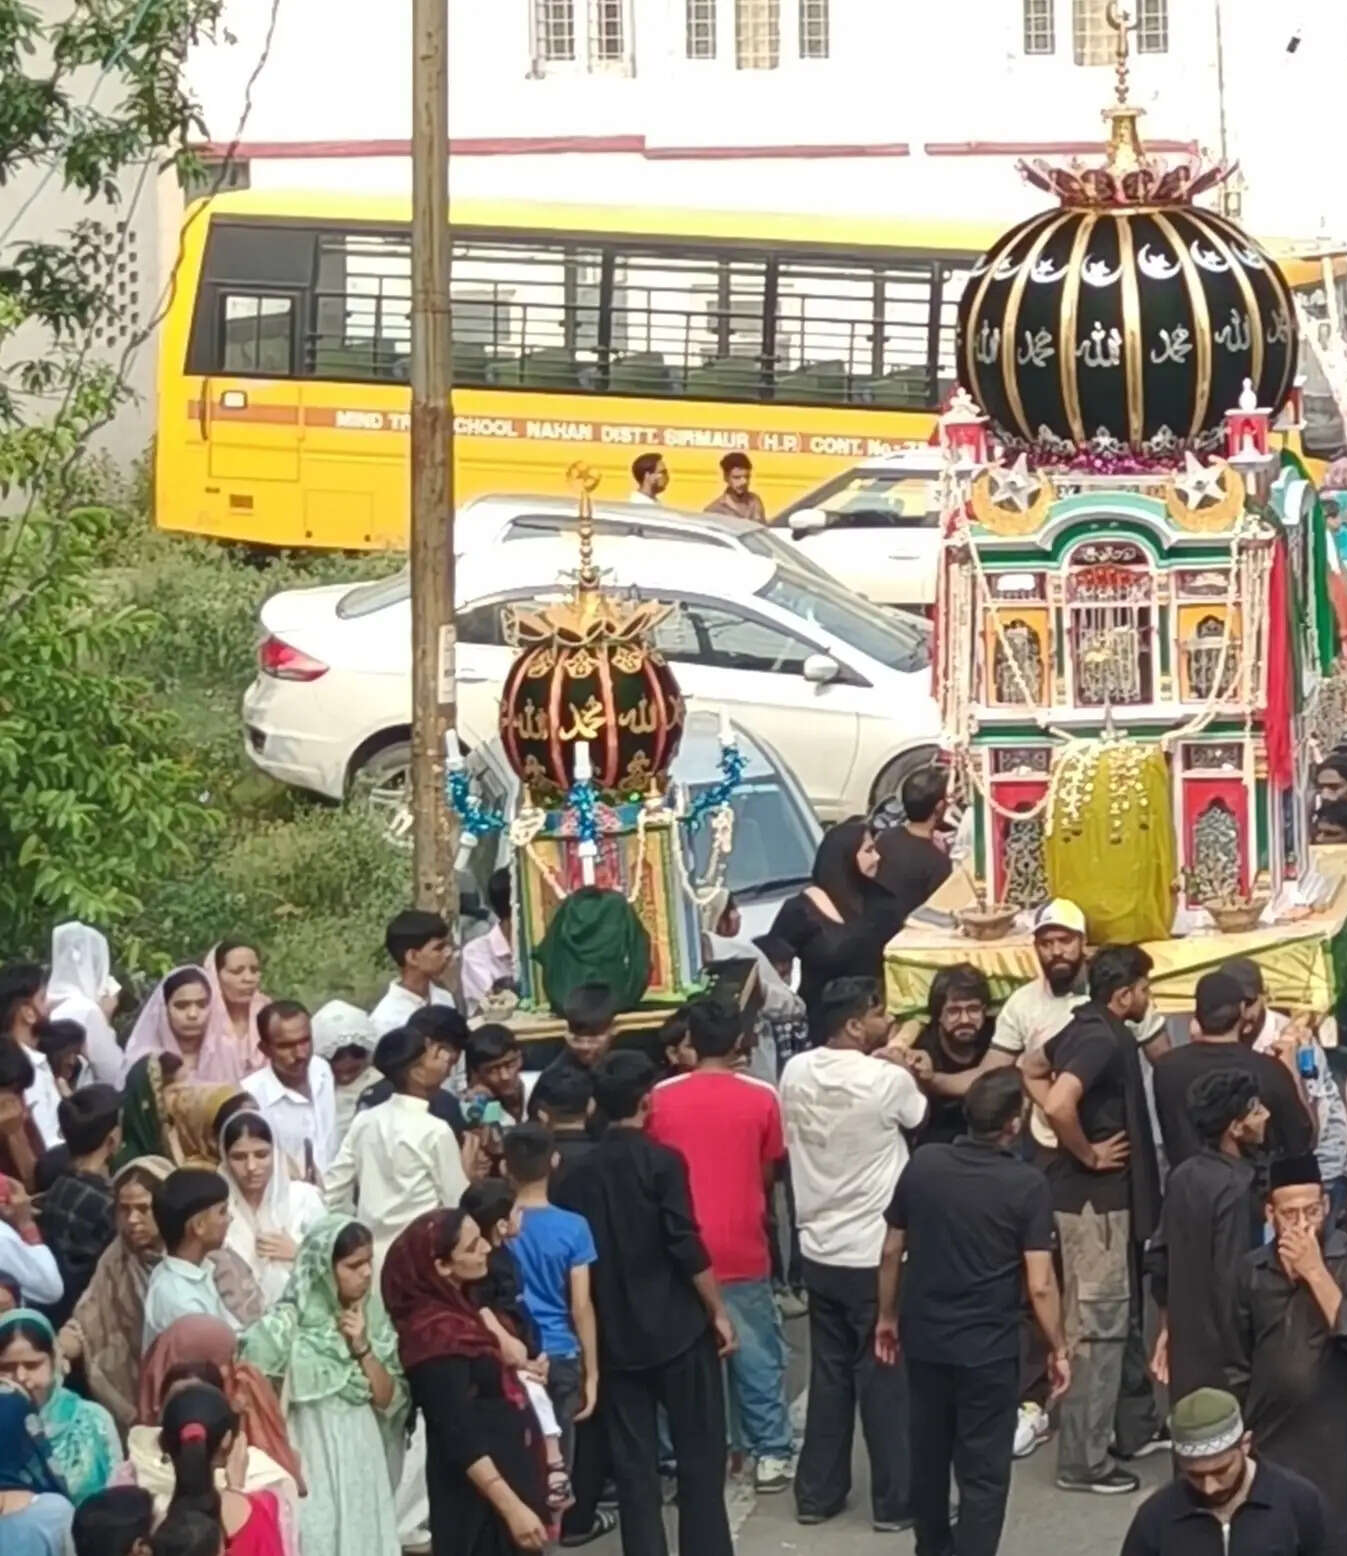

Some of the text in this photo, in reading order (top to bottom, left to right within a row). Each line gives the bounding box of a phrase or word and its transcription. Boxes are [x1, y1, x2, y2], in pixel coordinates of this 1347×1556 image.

[335, 410, 383, 429] MIND
[453, 416, 518, 437] CHOOL
[526, 420, 593, 440] NAHAN
[664, 427, 750, 449] SIRMAUR
